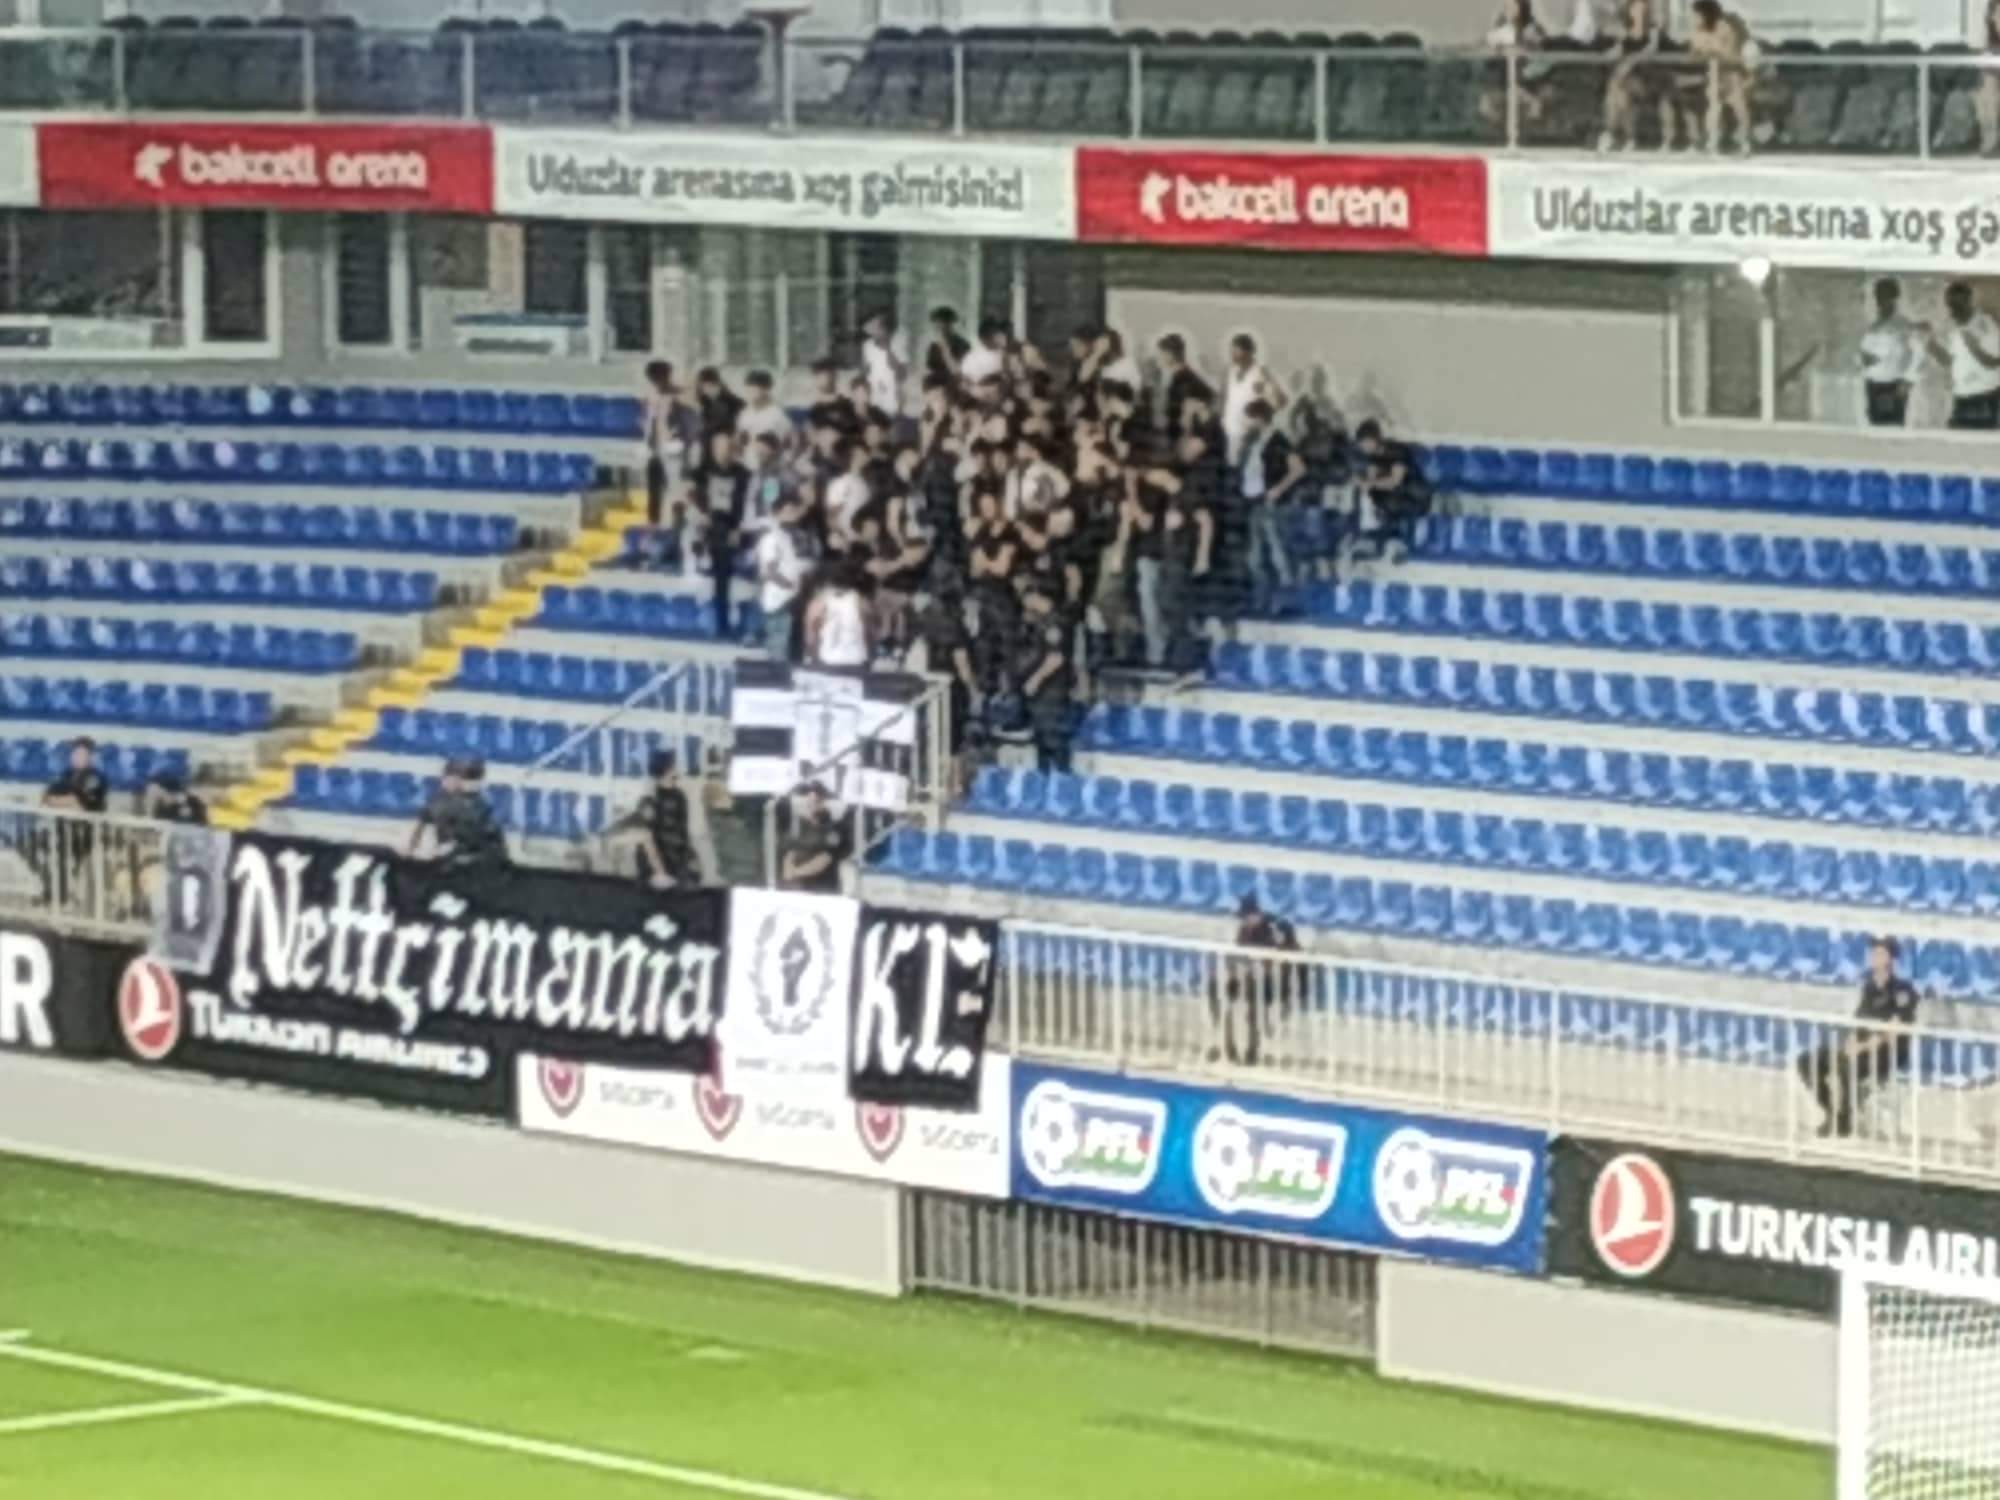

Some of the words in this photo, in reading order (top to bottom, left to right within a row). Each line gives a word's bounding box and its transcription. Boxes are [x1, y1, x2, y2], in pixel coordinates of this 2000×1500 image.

[179, 142, 320, 186] bakcell
[326, 151, 427, 188] arena
[528, 152, 644, 195] Ulduzlar
[1177, 174, 1299, 223] bakcell
[1306, 183, 1409, 228] arena
[1534, 186, 1682, 235] Ulduzlar
[1689, 201, 1870, 239] arenasına
[1879, 206, 1942, 254] xoş
[1084, 1117, 1144, 1165] PFL
[1258, 1141, 1322, 1192] PFL
[1441, 1168, 1507, 1215] PFL
[1689, 1197, 1890, 1272] TURKISH
